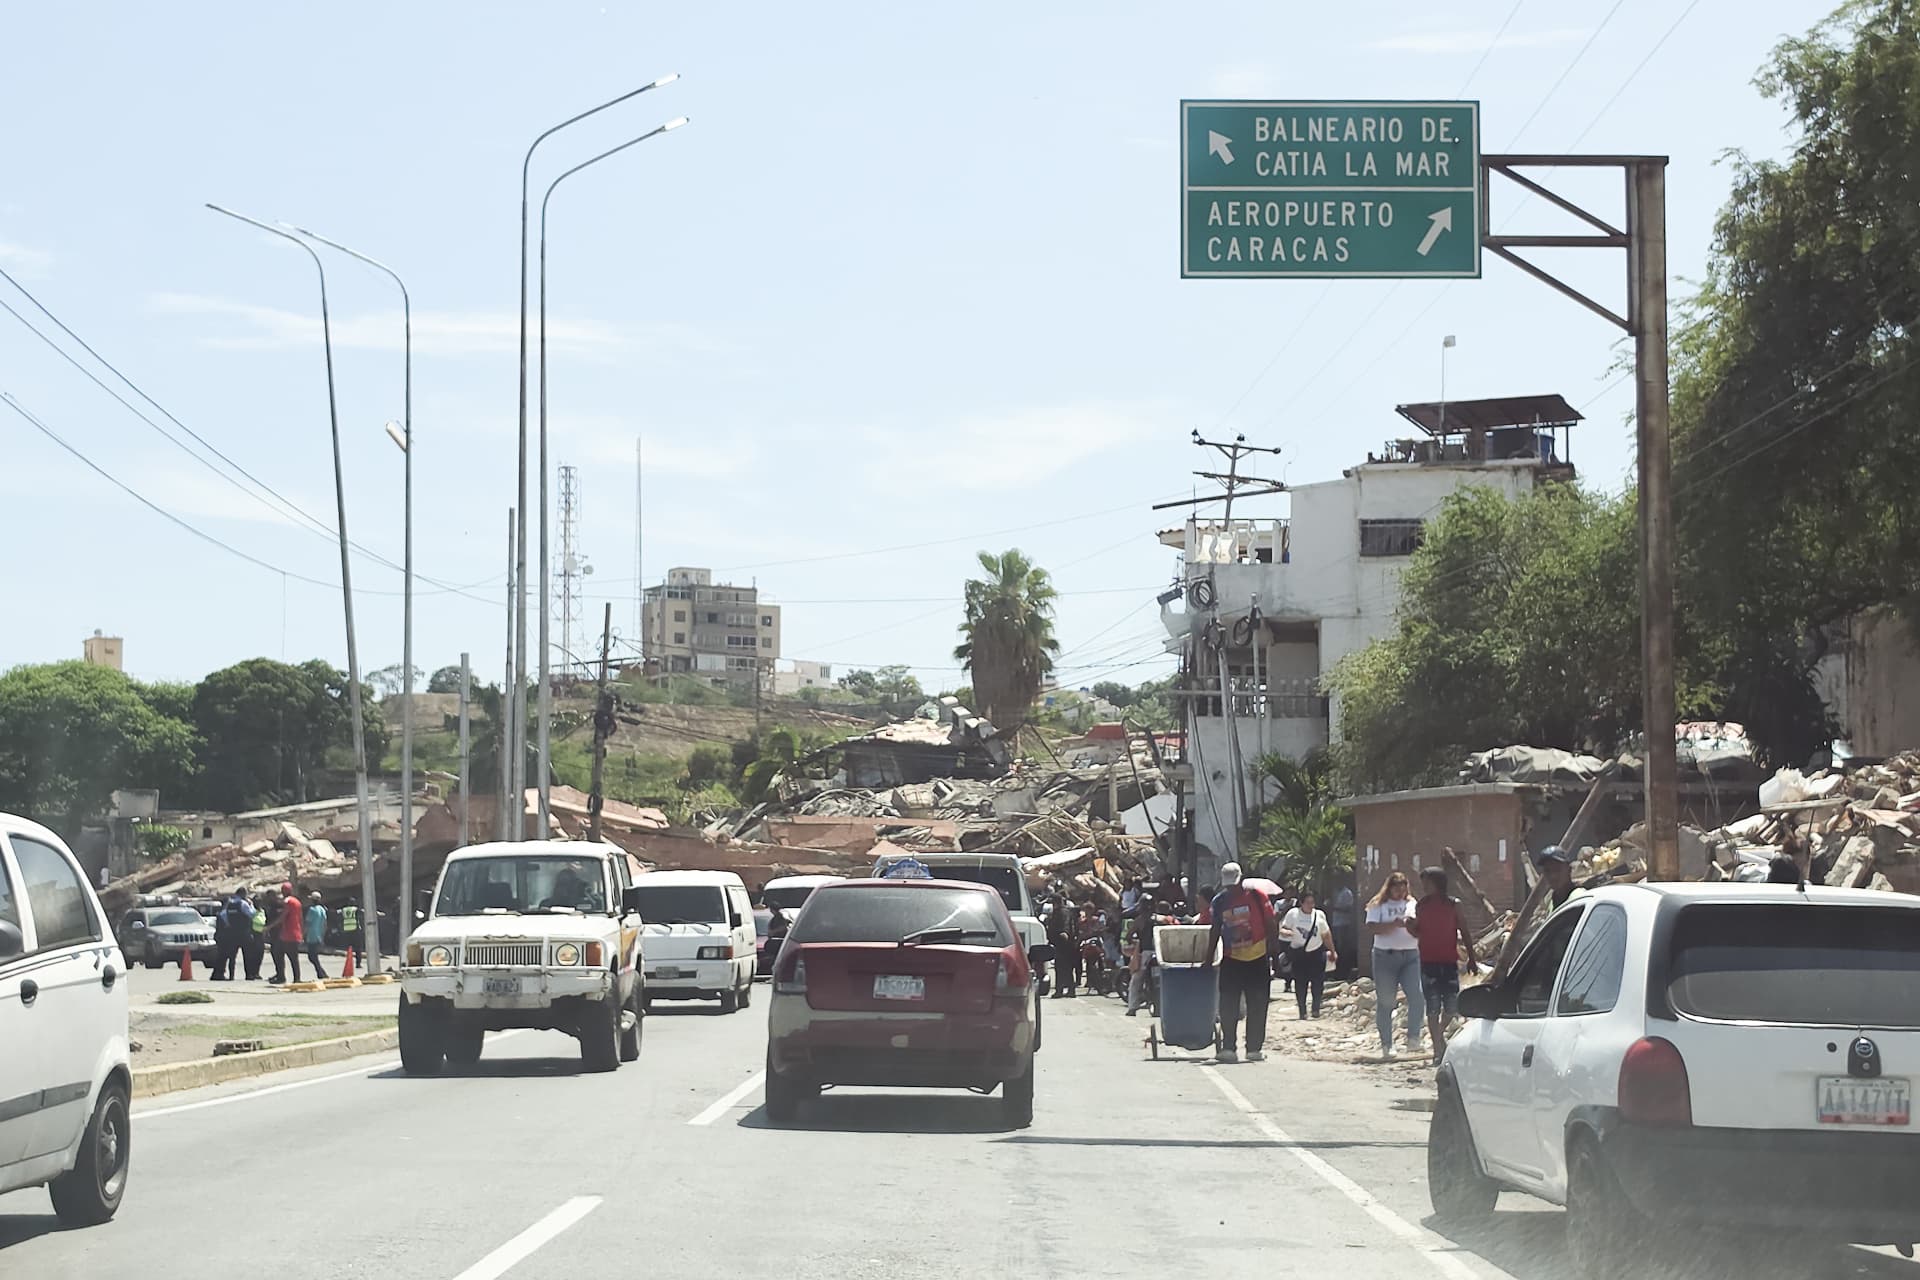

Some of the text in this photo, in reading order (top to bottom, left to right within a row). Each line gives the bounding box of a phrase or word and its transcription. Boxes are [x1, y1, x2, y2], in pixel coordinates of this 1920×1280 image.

[1255, 117, 1454, 143] BALNEARIO DE
[1256, 152, 1450, 177] CATIA LA MAR
[1207, 201, 1394, 227] AEROPUERTO
[1207, 236, 1350, 262] CARACAS
